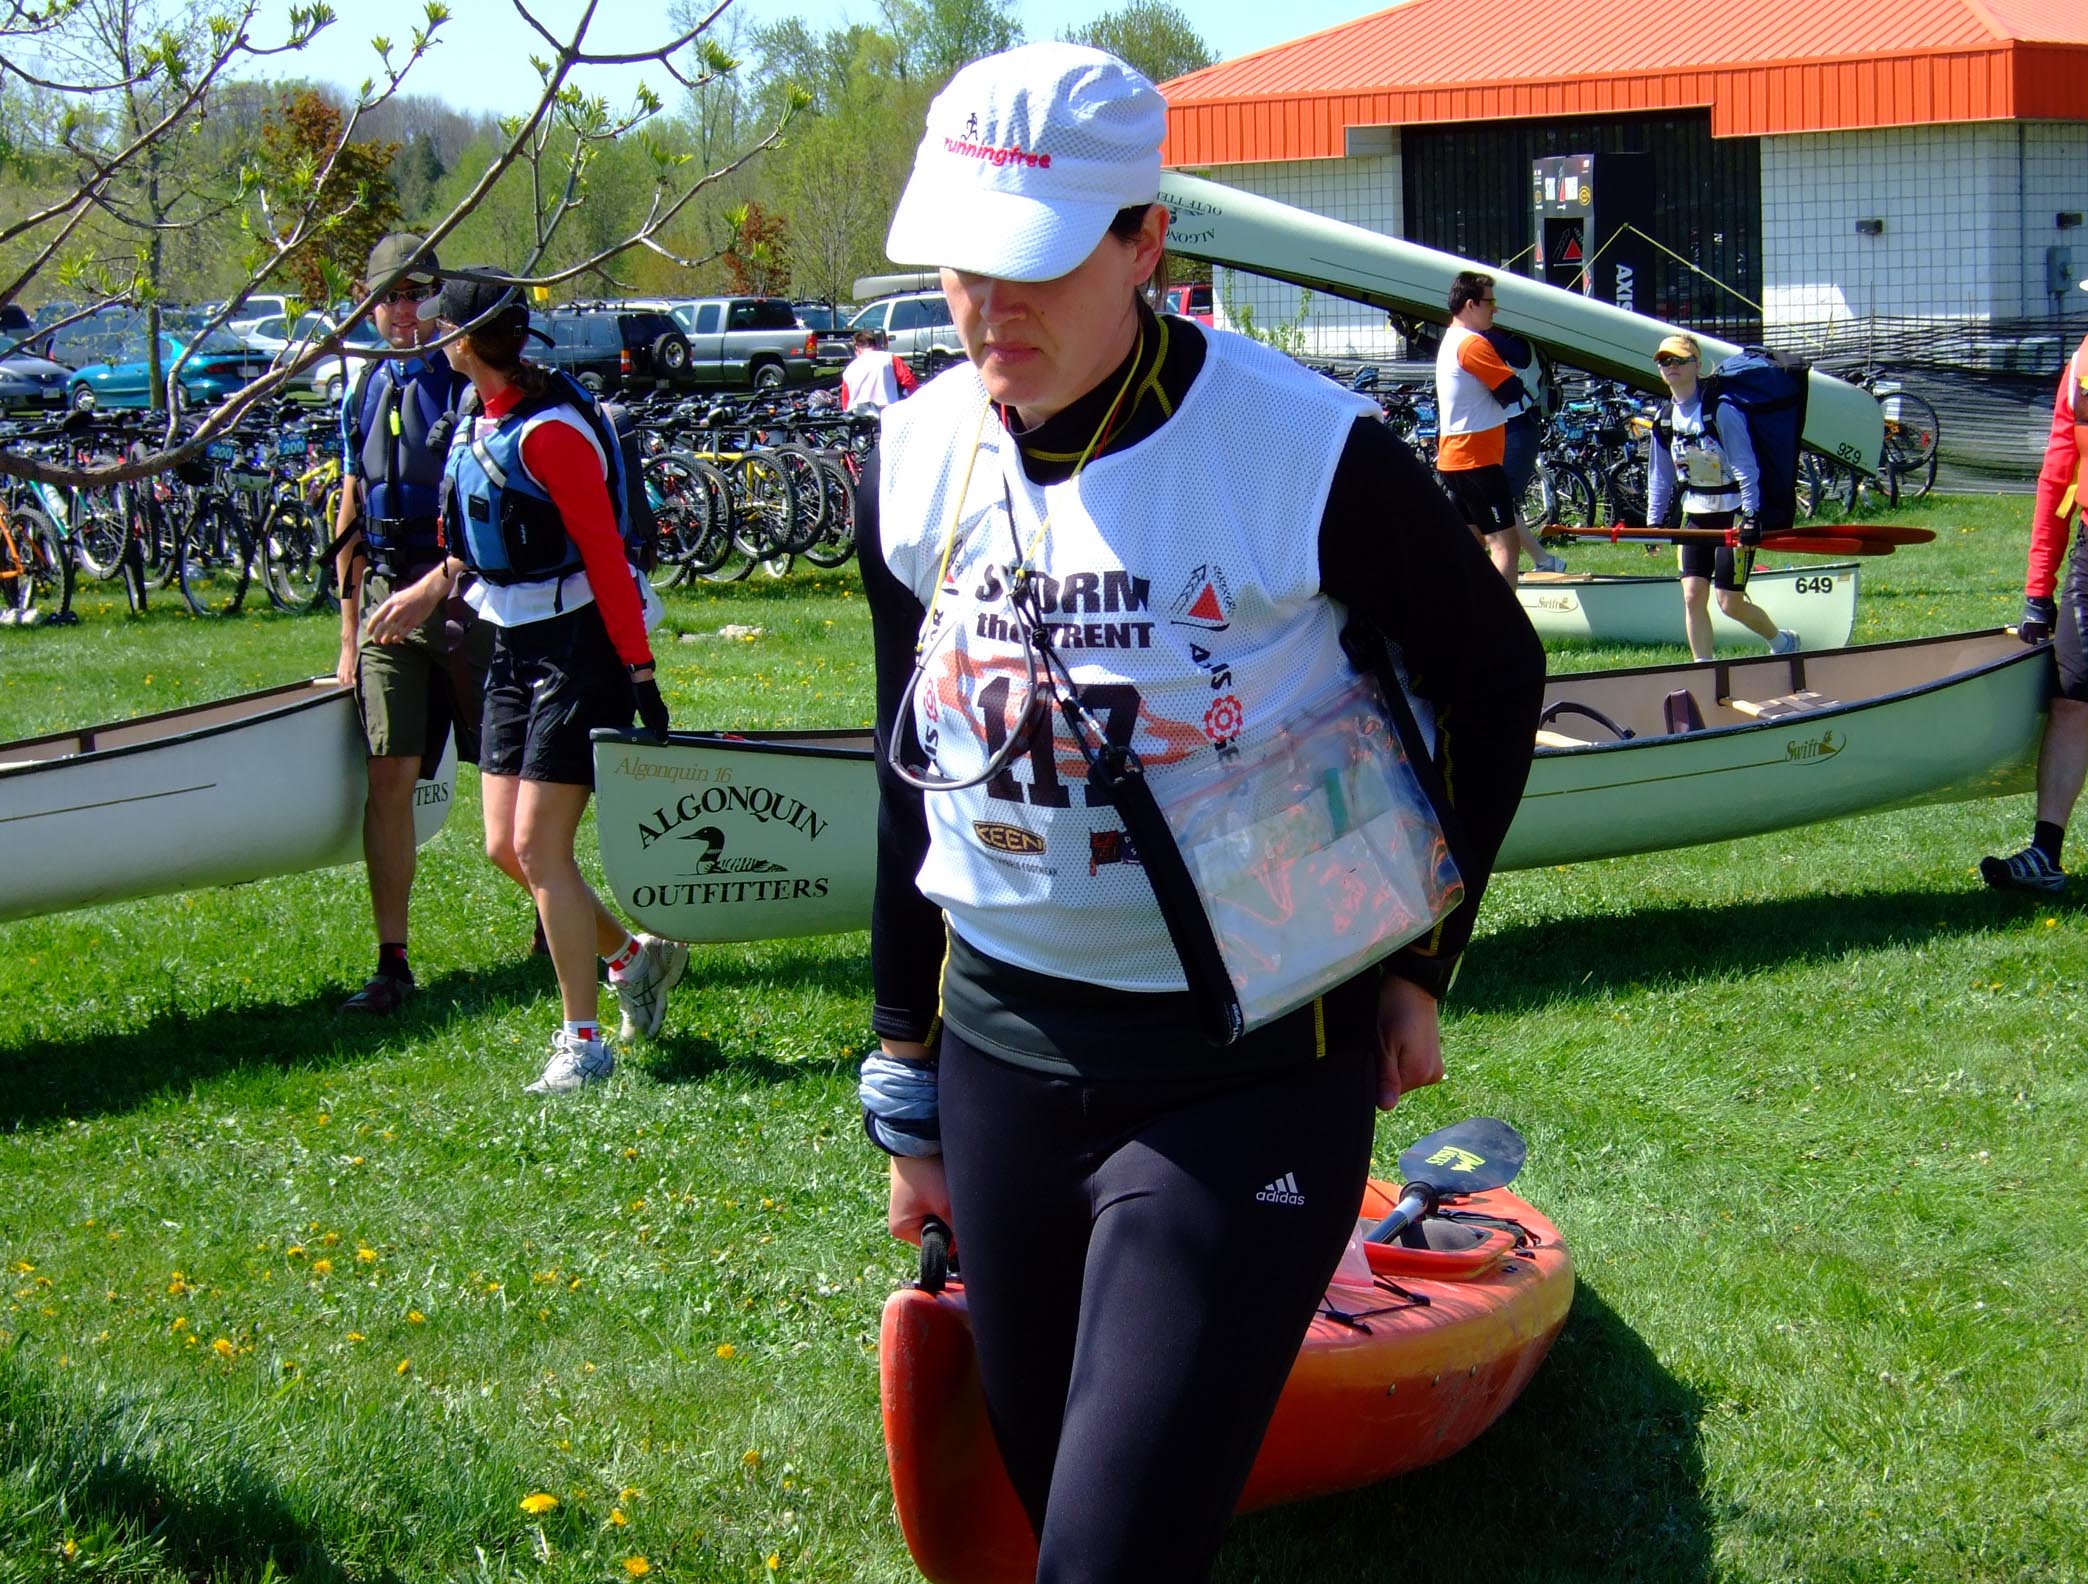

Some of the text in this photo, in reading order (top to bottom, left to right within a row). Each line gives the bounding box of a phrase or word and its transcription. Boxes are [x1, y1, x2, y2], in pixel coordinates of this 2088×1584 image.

[943, 137, 1051, 169] runningfree
[283, 440, 306, 454] 200
[1836, 441, 1862, 465] 626
[1795, 576, 1833, 595] 649
[1040, 621, 1155, 649] TRENT
[614, 757, 734, 784] Algonquin 16
[414, 781, 449, 806] TERS
[636, 786, 829, 850] ALGONQUIN
[974, 824, 1043, 850] KEEN
[632, 878, 829, 909] OUTFITTERS
[1256, 1190, 1305, 1206] adidas
